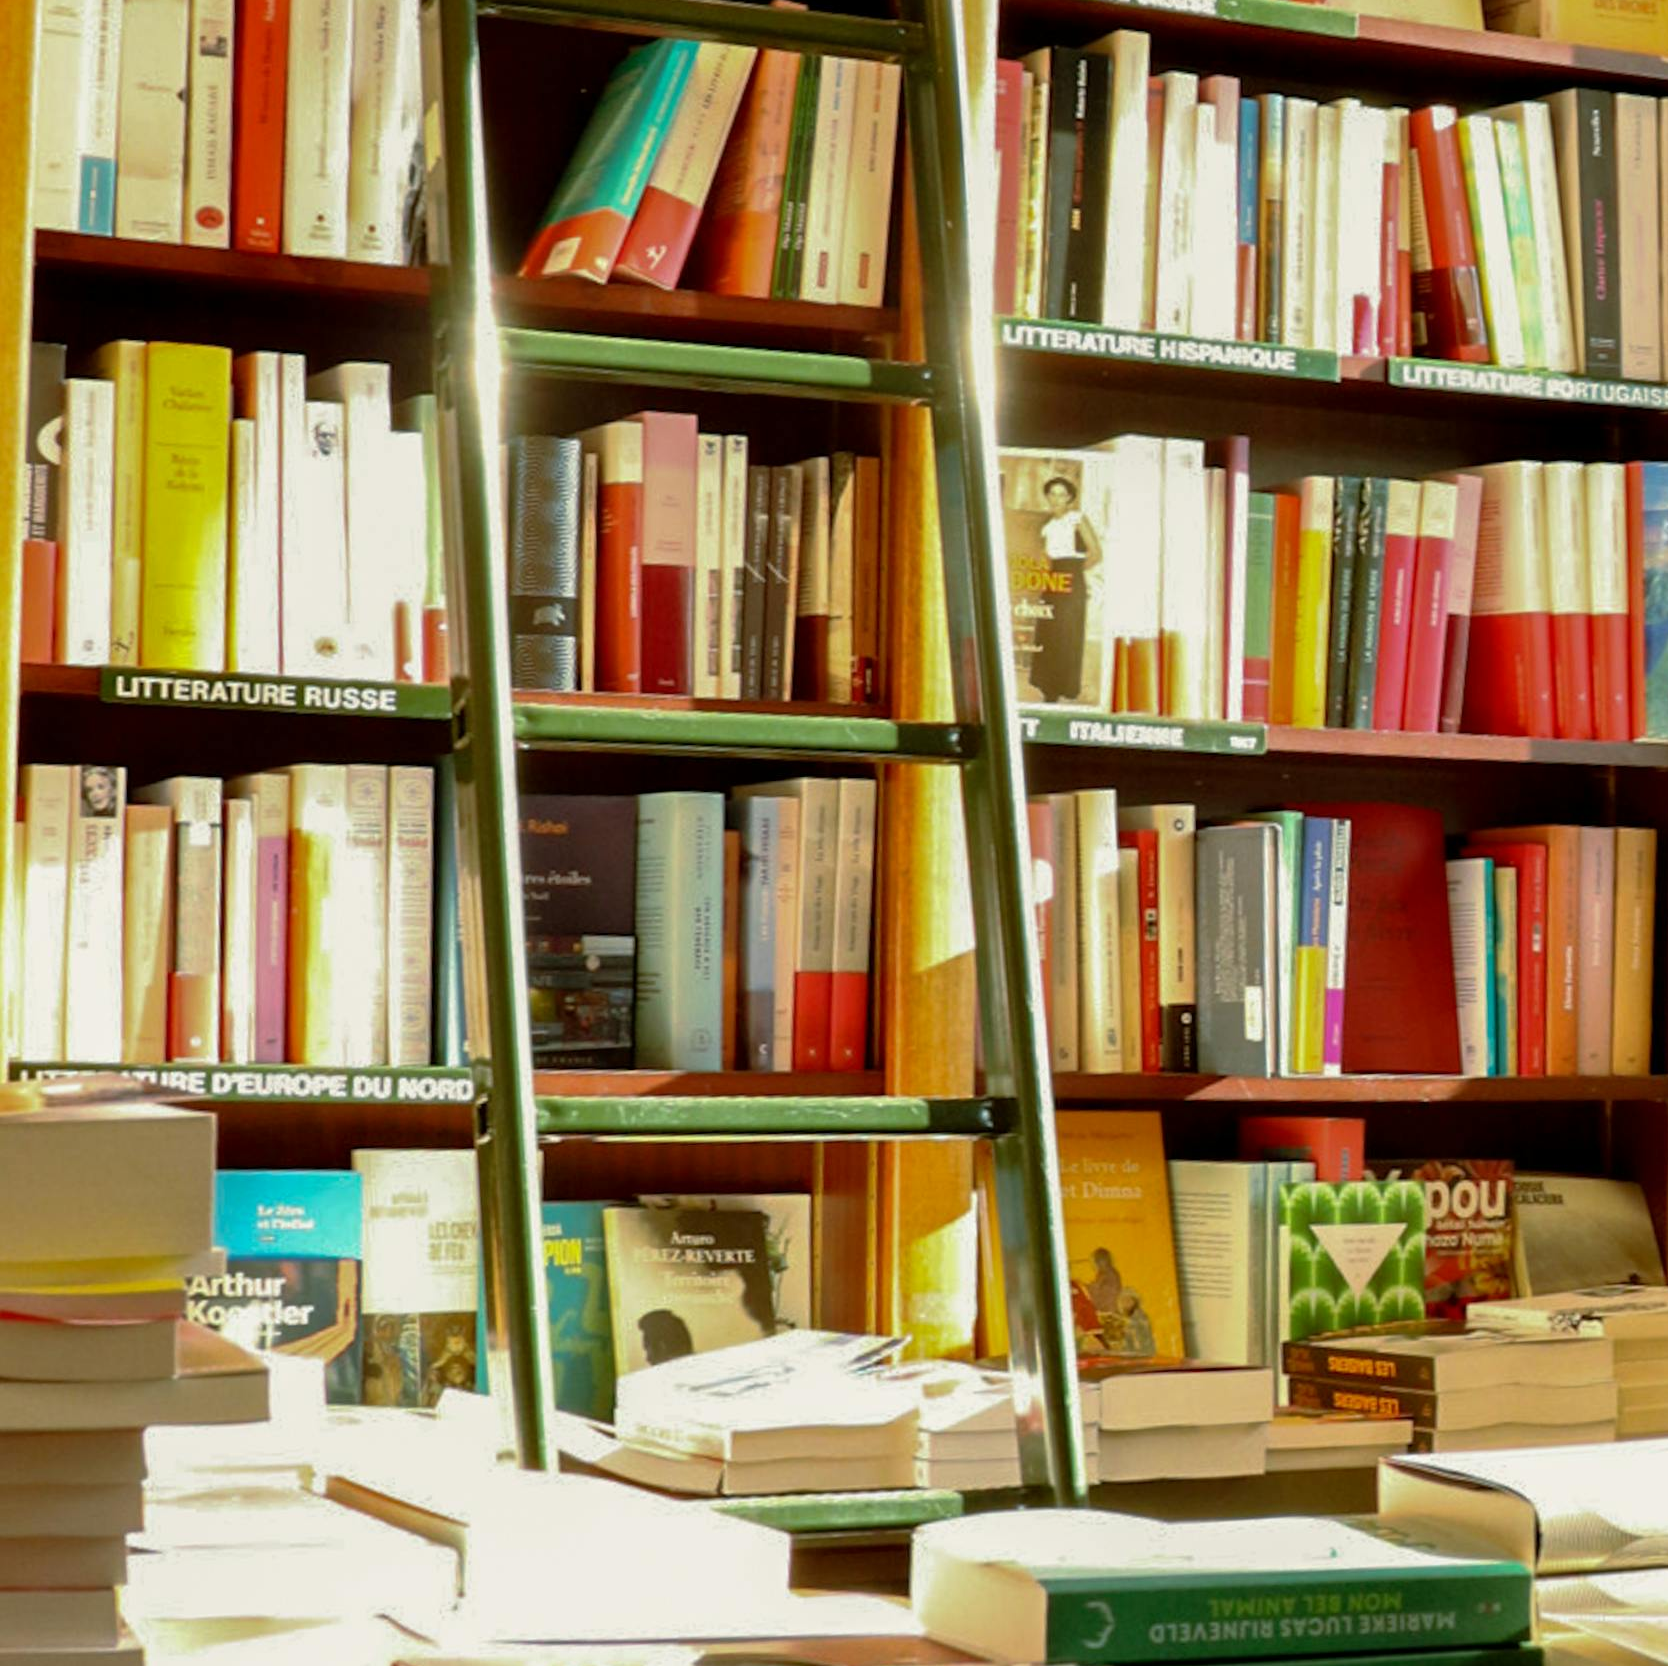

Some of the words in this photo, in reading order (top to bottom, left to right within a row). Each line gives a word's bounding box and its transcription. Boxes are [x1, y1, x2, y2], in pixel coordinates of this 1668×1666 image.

[1003, 324, 1157, 358] LITTERATURE
[1160, 338, 1297, 371] HISPANIQUE
[1402, 364, 1543, 397] LITTERATURE
[1011, 572, 1073, 593] DONE
[115, 675, 297, 707] LITTERATURE
[304, 685, 397, 712] RUSSE
[20, 1069, 206, 1094] LITURE
[211, 1071, 348, 1097] D'EUROPE
[352, 1075, 392, 1100] DU
[397, 1077, 475, 1101] NORD
[670, 1231, 716, 1246] Arturo
[544, 1238, 582, 1266] PION
[187, 1272, 286, 1298] Arthur
[187, 1299, 315, 1326] Koeler
[1209, 1595, 1296, 1619] ANIMAL
[1301, 1593, 1342, 1613] BEL
[1346, 1592, 1401, 1611] MON
[1149, 1617, 1273, 1644] RIJNEVELD
[1279, 1614, 1355, 1637] LUCAS
[1358, 1612, 1456, 1634] MARIEKE
